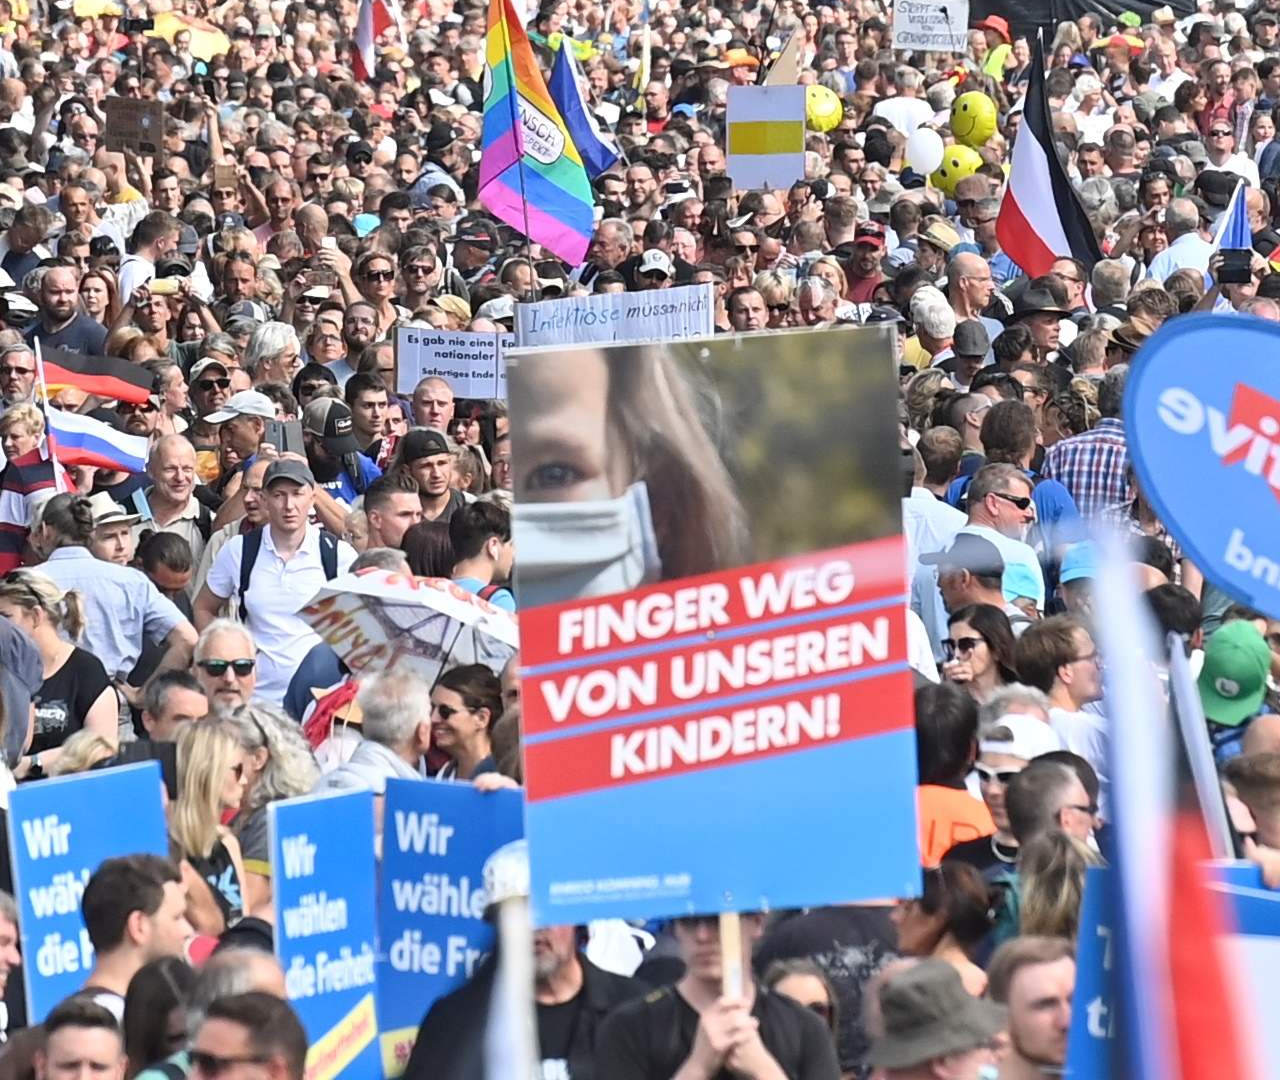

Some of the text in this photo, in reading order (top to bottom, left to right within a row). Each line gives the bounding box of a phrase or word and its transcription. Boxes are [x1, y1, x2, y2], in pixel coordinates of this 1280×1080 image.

[407, 334, 419, 344] Es
[422, 334, 445, 347] gab
[448, 336, 466, 347] nie
[468, 337, 495, 348] eine
[434, 349, 495, 361] nationaler
[558, 560, 855, 655] FINGER WEG
[540, 616, 890, 723] VON UNSEREN
[610, 692, 841, 778] KINDERN!
[22, 814, 72, 861] Wir
[281, 833, 317, 880] Wir
[394, 809, 455, 856] Wir
[29, 867, 91, 919] wäh
[282, 890, 348, 939] wählen
[391, 872, 487, 921] wähle
[36, 931, 80, 977] die
[285, 941, 377, 1000] die Freiheit
[389, 929, 442, 976] die
